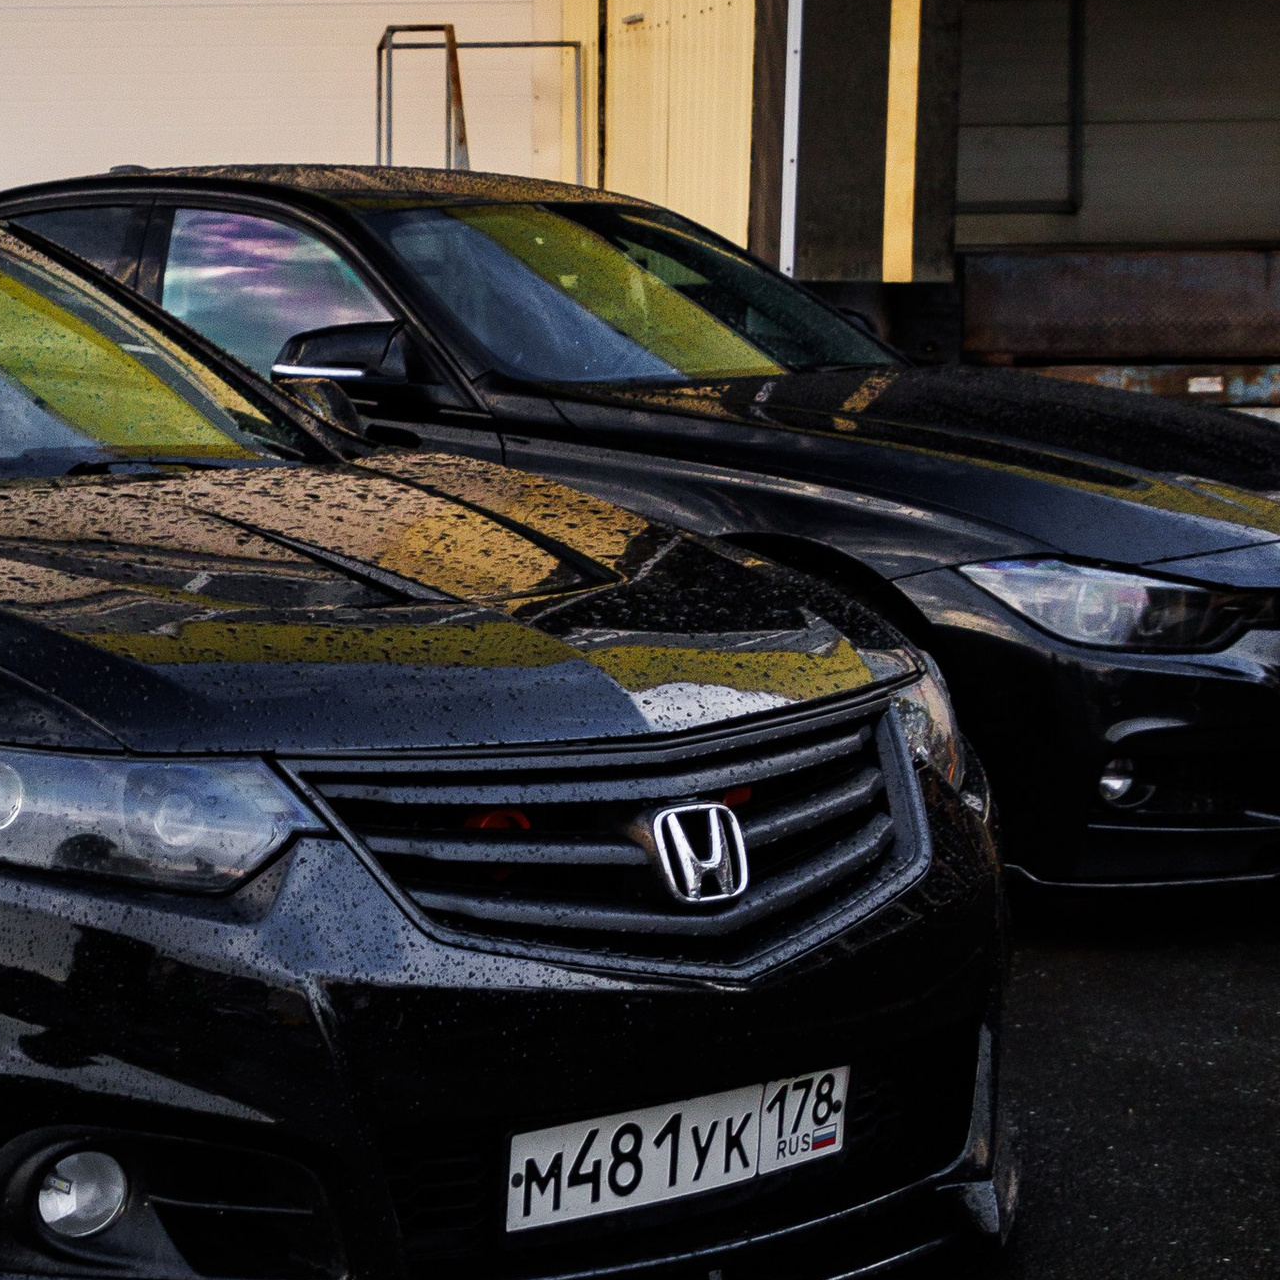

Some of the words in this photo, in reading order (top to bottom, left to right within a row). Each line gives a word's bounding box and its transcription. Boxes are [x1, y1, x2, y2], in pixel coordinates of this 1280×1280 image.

[522, 1112, 752, 1217] М481УК
[766, 1073, 835, 1139] 178
[777, 1132, 811, 1161] RUS
